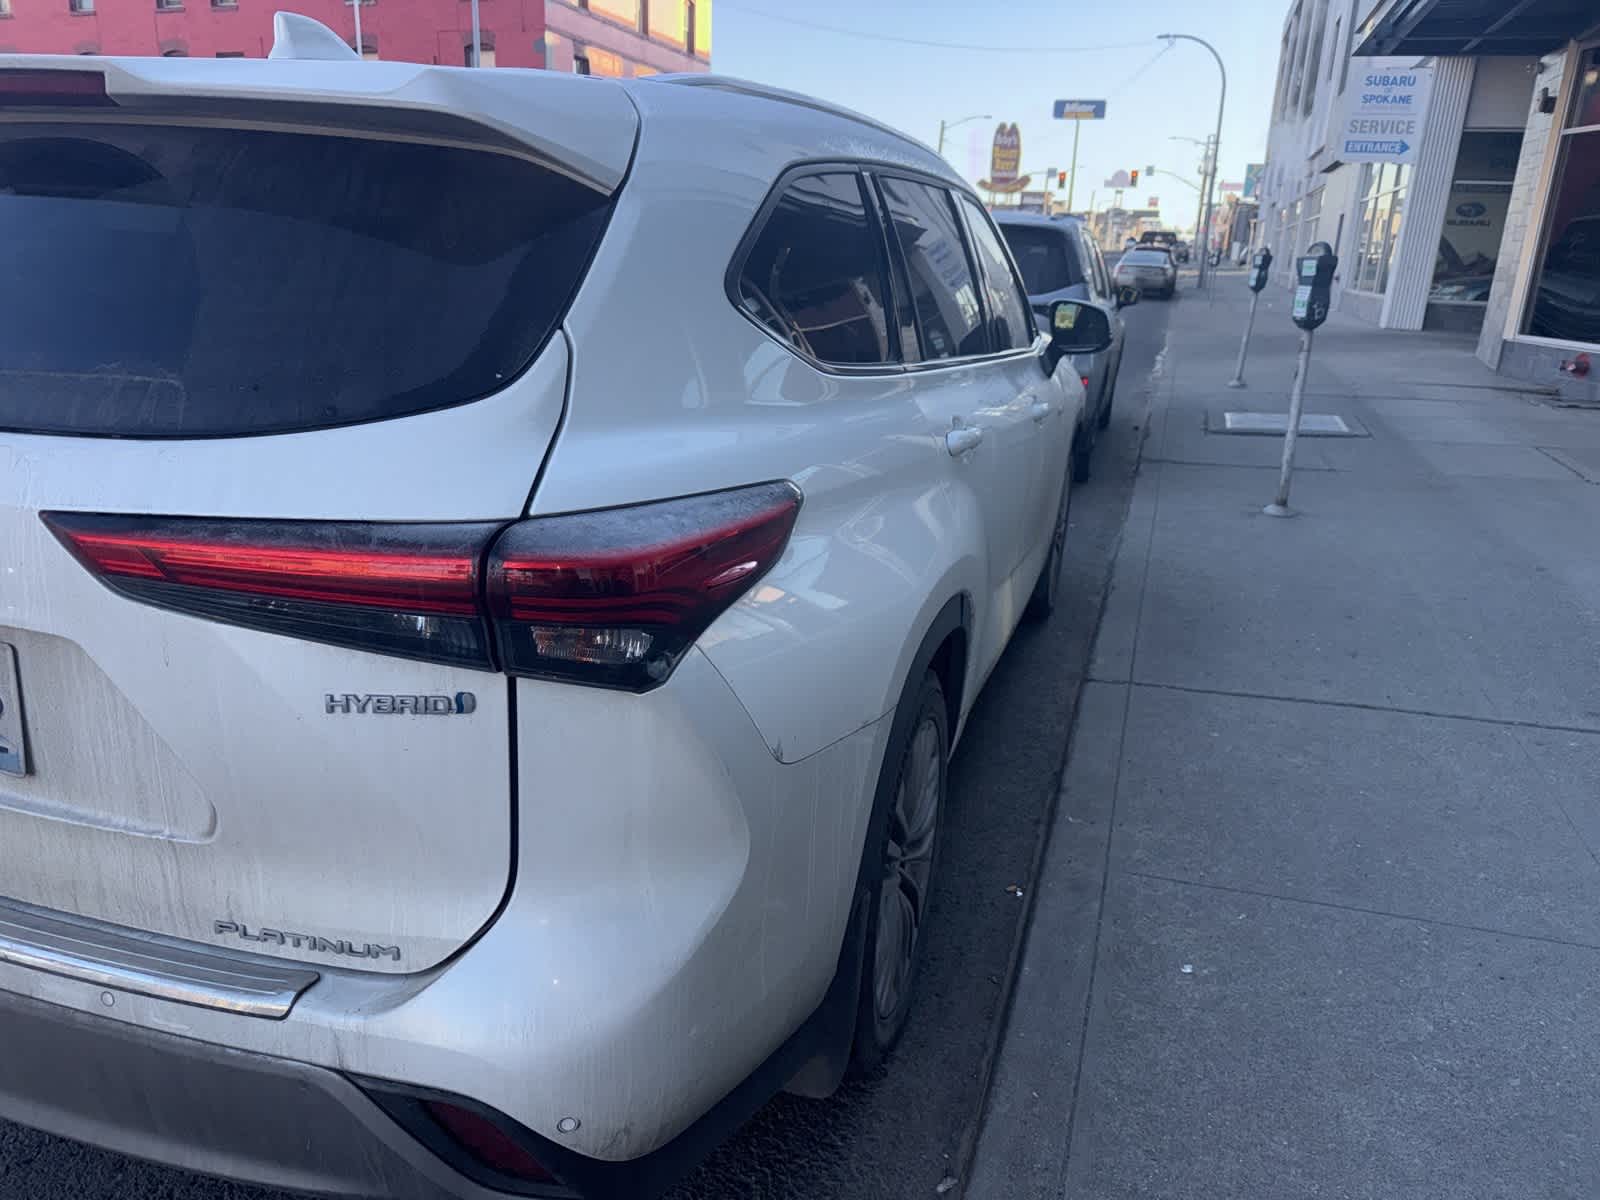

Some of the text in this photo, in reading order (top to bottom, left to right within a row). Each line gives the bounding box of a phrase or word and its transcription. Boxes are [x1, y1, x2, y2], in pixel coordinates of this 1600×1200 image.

[1365, 75, 1417, 87] SUBARU
[1361, 94, 1413, 104] SPOKANE
[1349, 119, 1416, 135] SERVICE
[1347, 141, 1402, 153] ENTRANCE
[324, 693, 456, 716] HYBRID
[214, 919, 402, 962] PLATINUM
